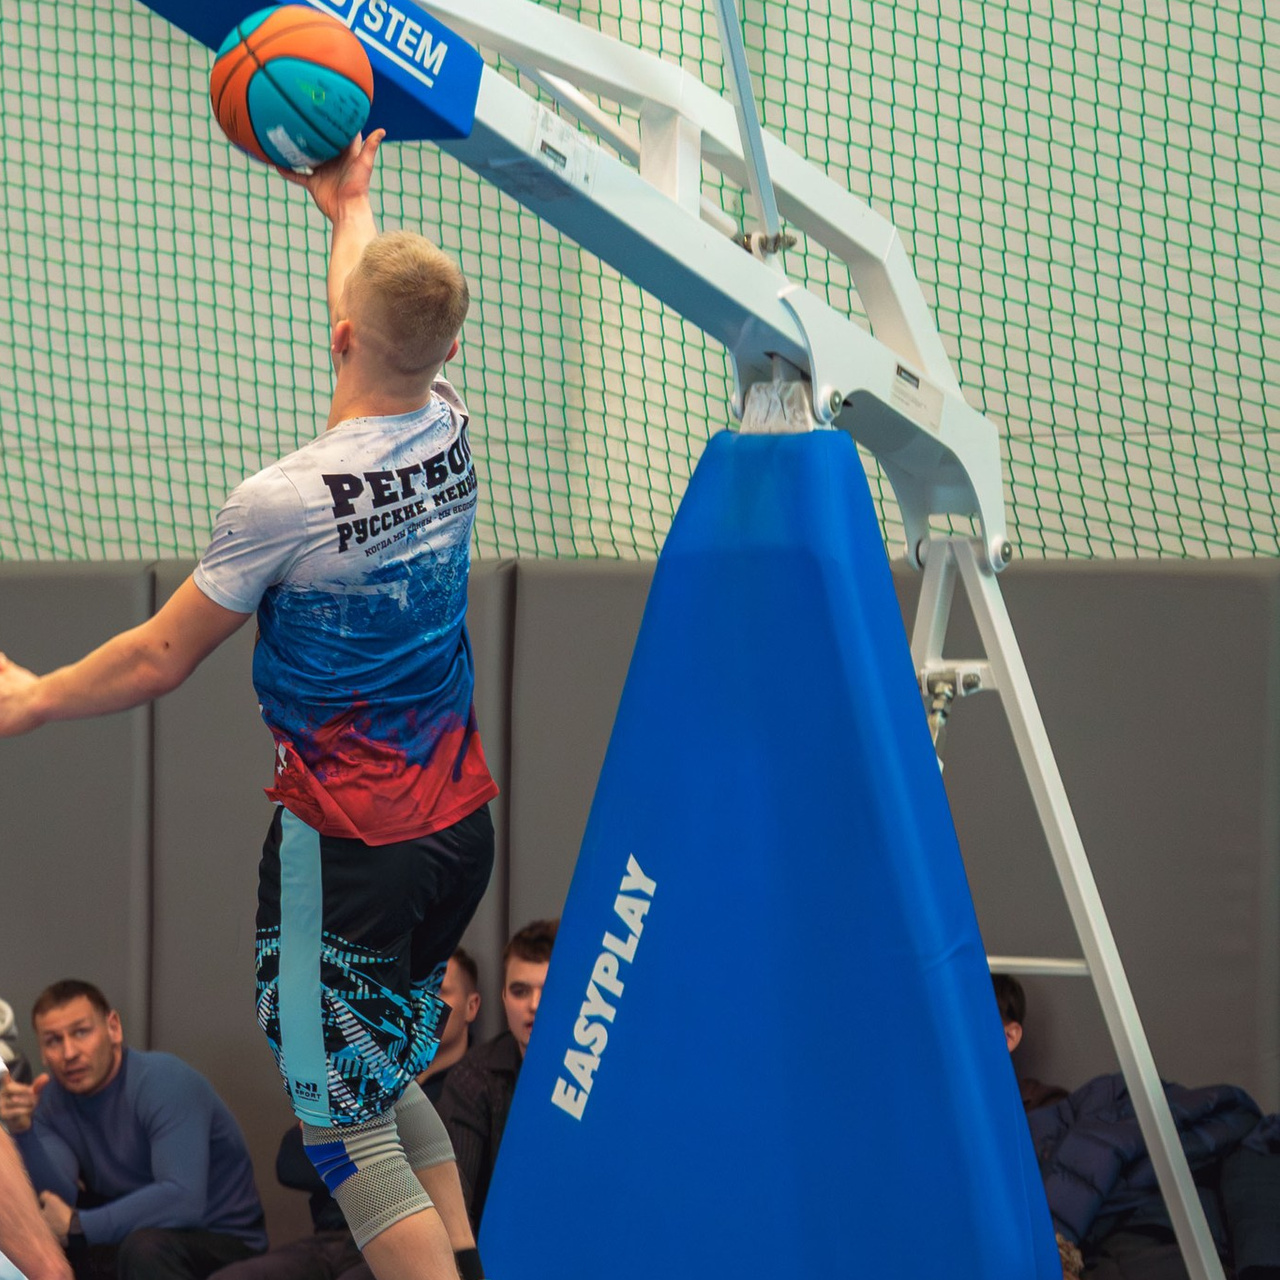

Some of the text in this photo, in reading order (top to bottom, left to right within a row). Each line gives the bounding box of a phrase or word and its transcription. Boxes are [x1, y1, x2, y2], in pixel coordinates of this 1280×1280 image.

[336, 499, 427, 554] РУССКИЕ
[364, 538, 393, 558] КОГДА
[393, 531, 407, 543] МЫ
[438, 508, 452, 522] МЫ
[550, 852, 657, 1121] EASYPLAY
